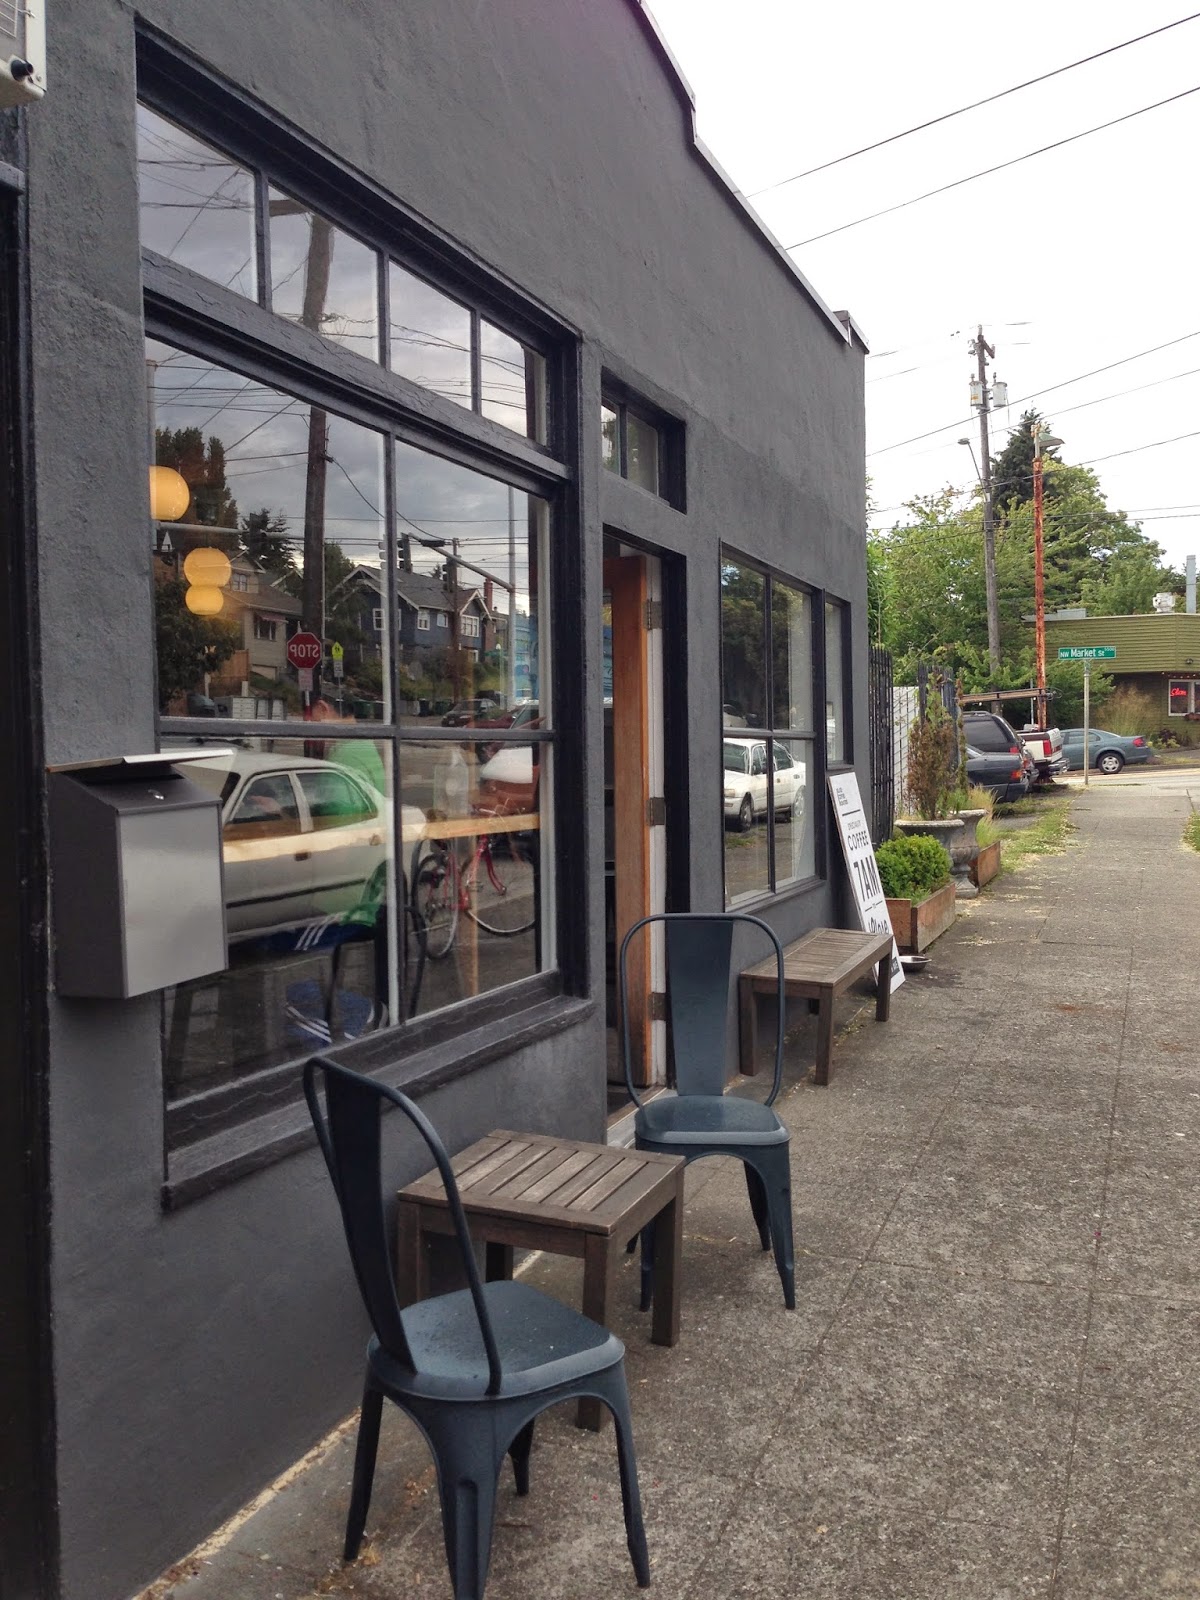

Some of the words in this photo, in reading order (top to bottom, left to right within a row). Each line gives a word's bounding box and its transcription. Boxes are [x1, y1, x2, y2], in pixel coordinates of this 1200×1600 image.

[1070, 648, 1097, 658] Market
[847, 830, 869, 851] COFFEE
[853, 855, 881, 902] 7AM
